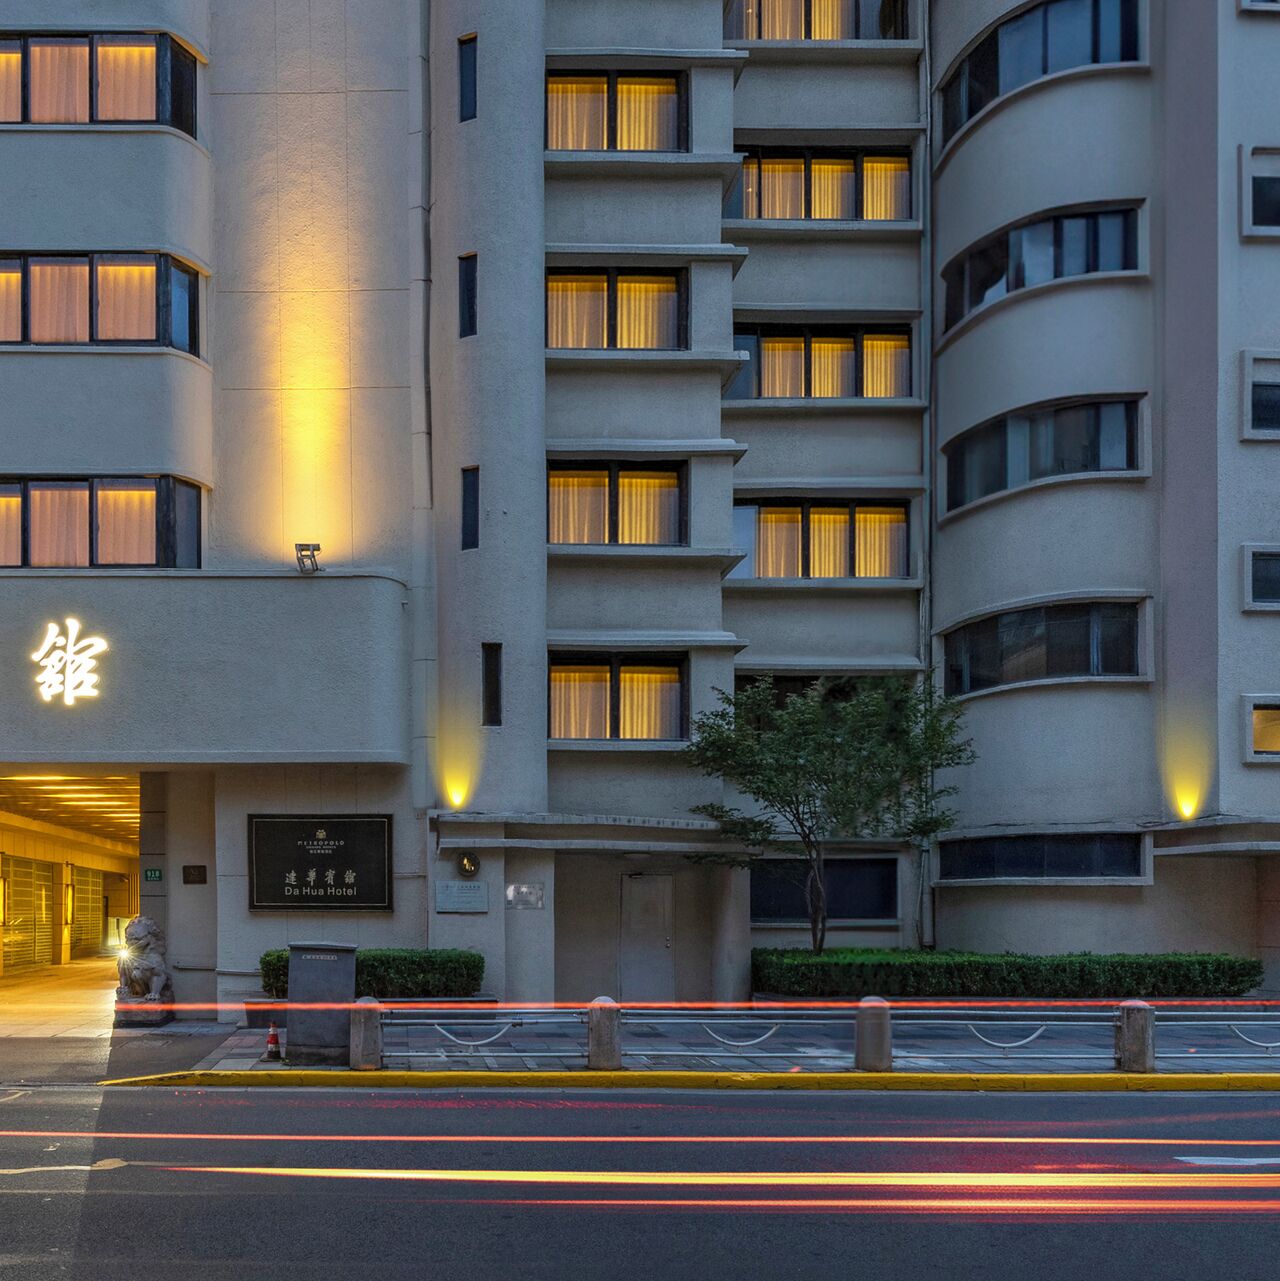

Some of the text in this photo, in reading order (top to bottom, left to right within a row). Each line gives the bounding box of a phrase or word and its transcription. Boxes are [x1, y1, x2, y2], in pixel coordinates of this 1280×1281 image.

[284, 886, 357, 896] Da Hua Hotel
